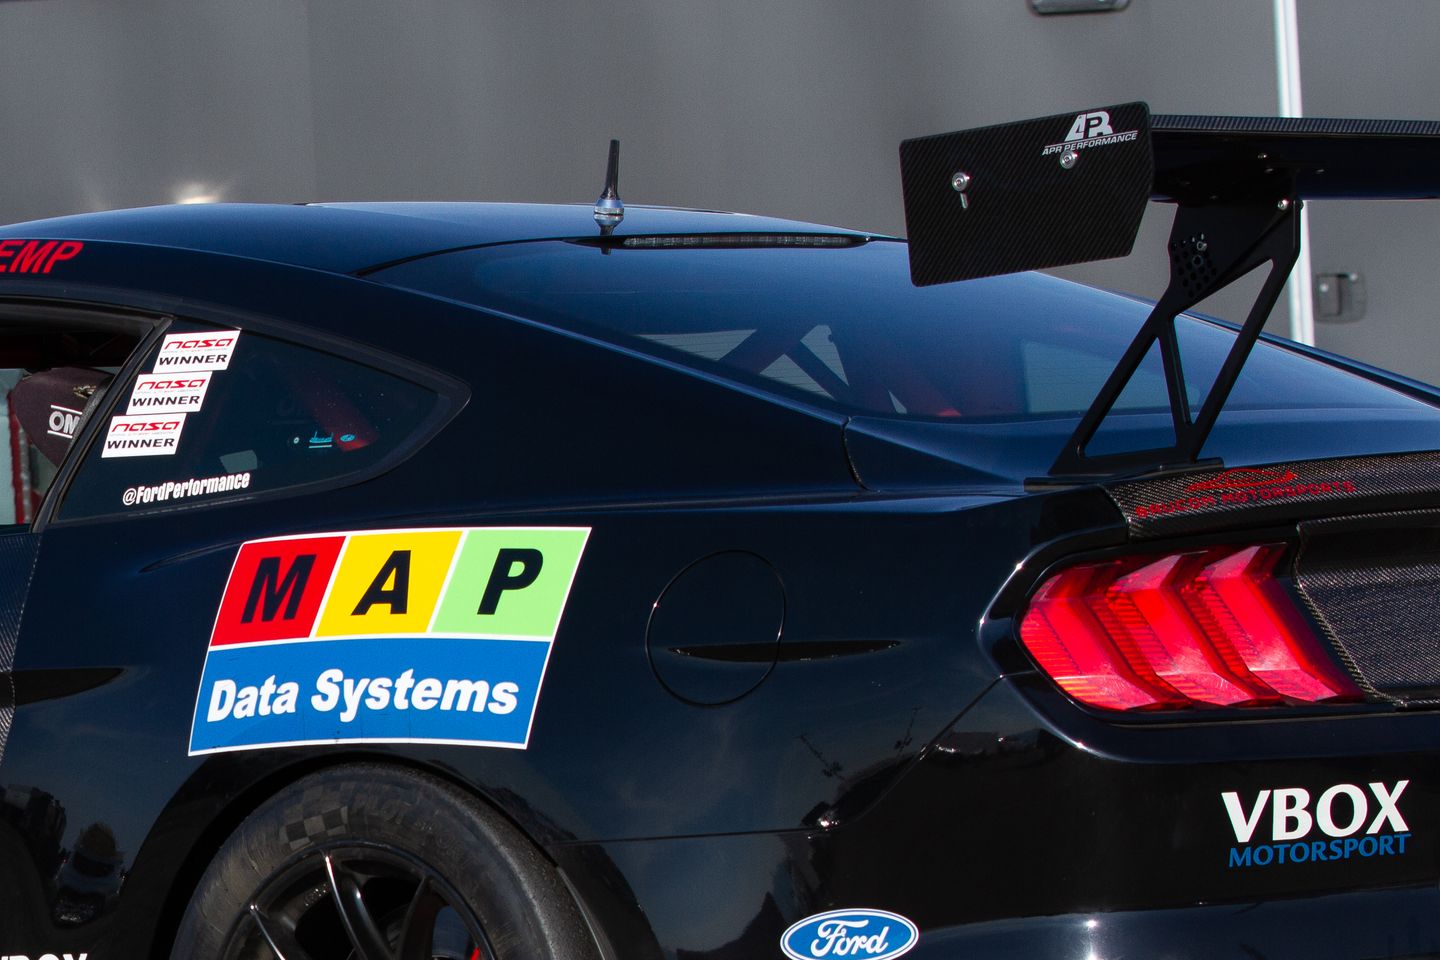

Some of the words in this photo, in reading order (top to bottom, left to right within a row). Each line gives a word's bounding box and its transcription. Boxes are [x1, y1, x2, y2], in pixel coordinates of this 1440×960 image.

[1063, 133, 1138, 152] PERFORMANCE
[164, 338, 234, 350] nasa
[159, 354, 228, 366] WINNER
[137, 378, 207, 391] nasa
[132, 395, 201, 407] WINNER
[49, 411, 81, 435] OM
[111, 421, 181, 433] nasa
[107, 438, 176, 450] WINNER
[123, 472, 250, 506] @FordPerformance
[241, 548, 544, 624] MAP
[207, 674, 299, 723] Data
[311, 668, 520, 723] Systems
[1221, 779, 1410, 843] VBOX
[1229, 833, 1412, 868] MOTORSPORT
[810, 918, 890, 955] Ford
